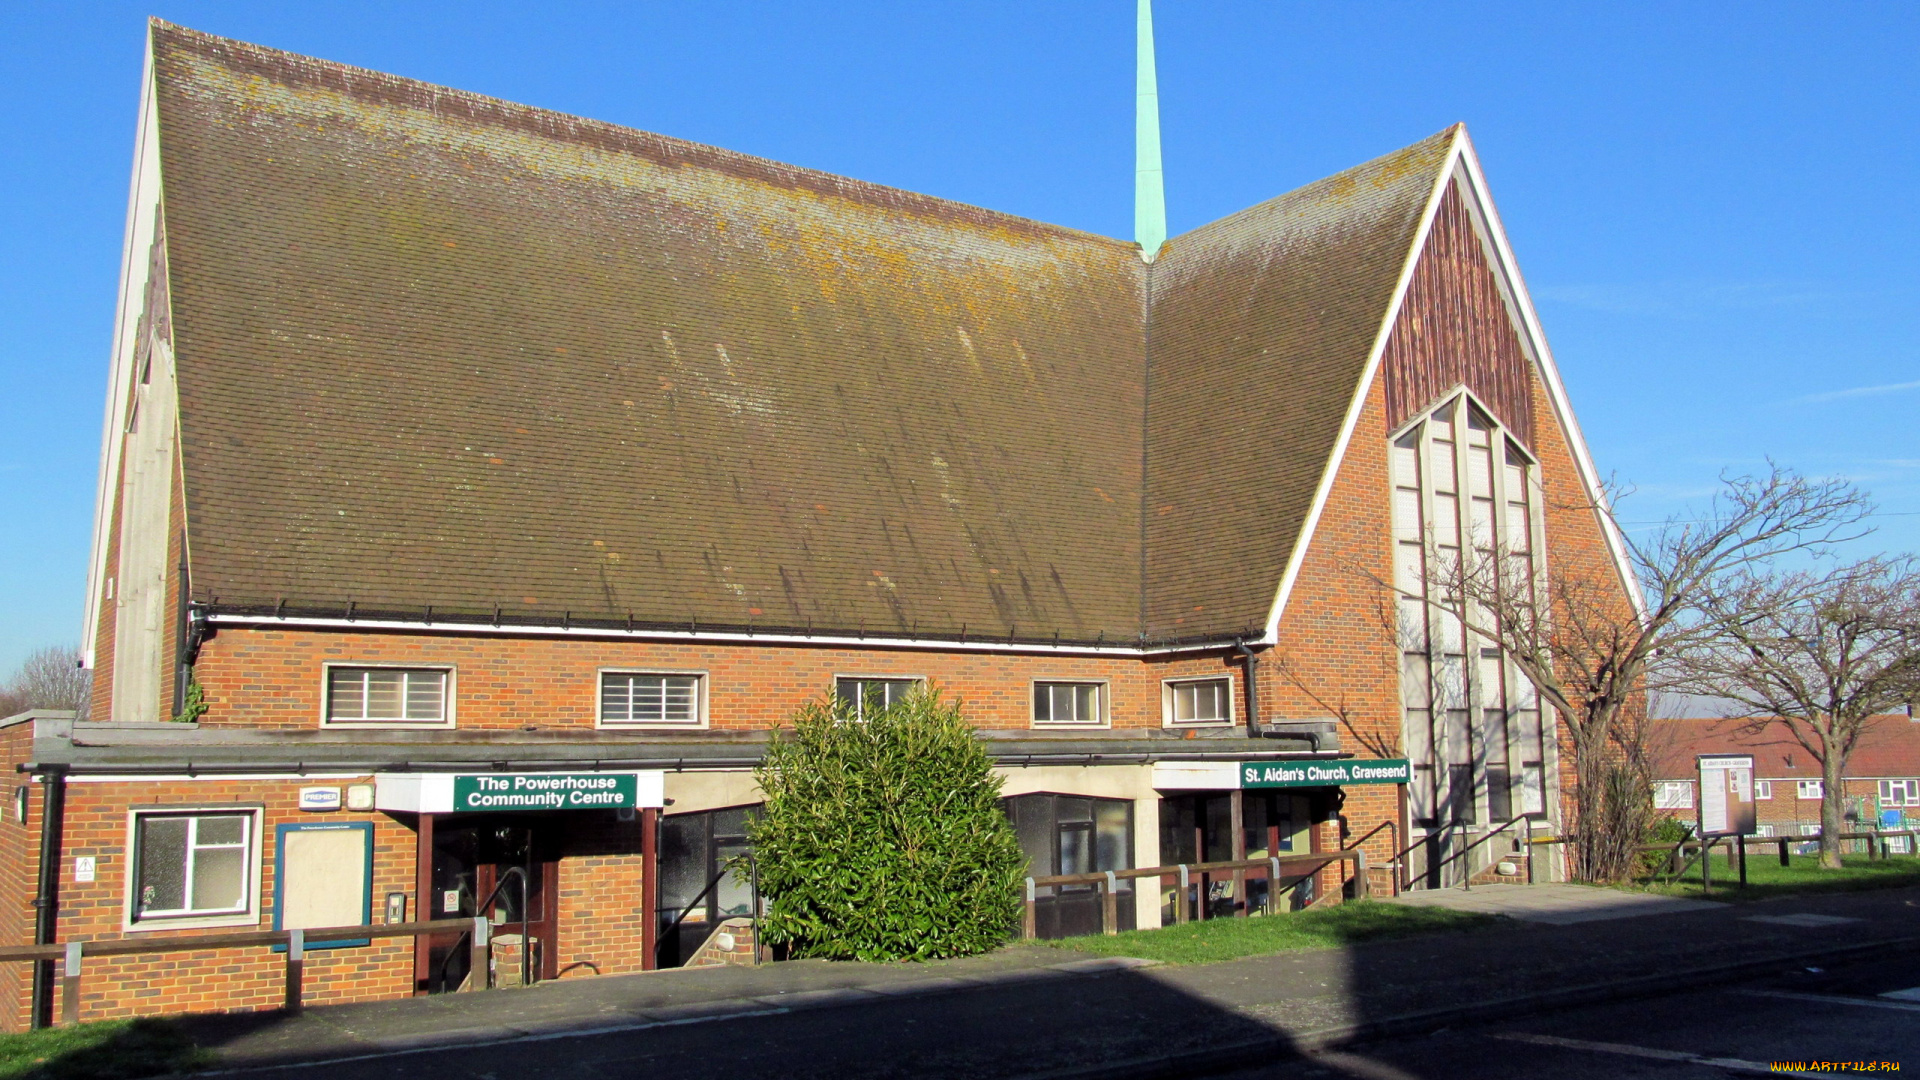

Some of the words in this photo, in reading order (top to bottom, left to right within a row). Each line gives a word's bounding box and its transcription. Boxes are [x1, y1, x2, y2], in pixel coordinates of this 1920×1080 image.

[1245, 767, 1261, 782] St.
[1264, 767, 1305, 782] Aidan's
[1307, 766, 1350, 781] Church,
[1352, 764, 1407, 779] Gravesend
[476, 777, 510, 790] The
[514, 776, 617, 790] Powerhouse
[305, 793, 337, 801] PREMIER
[467, 791, 566, 807] Community
[569, 791, 624, 804] Centre
